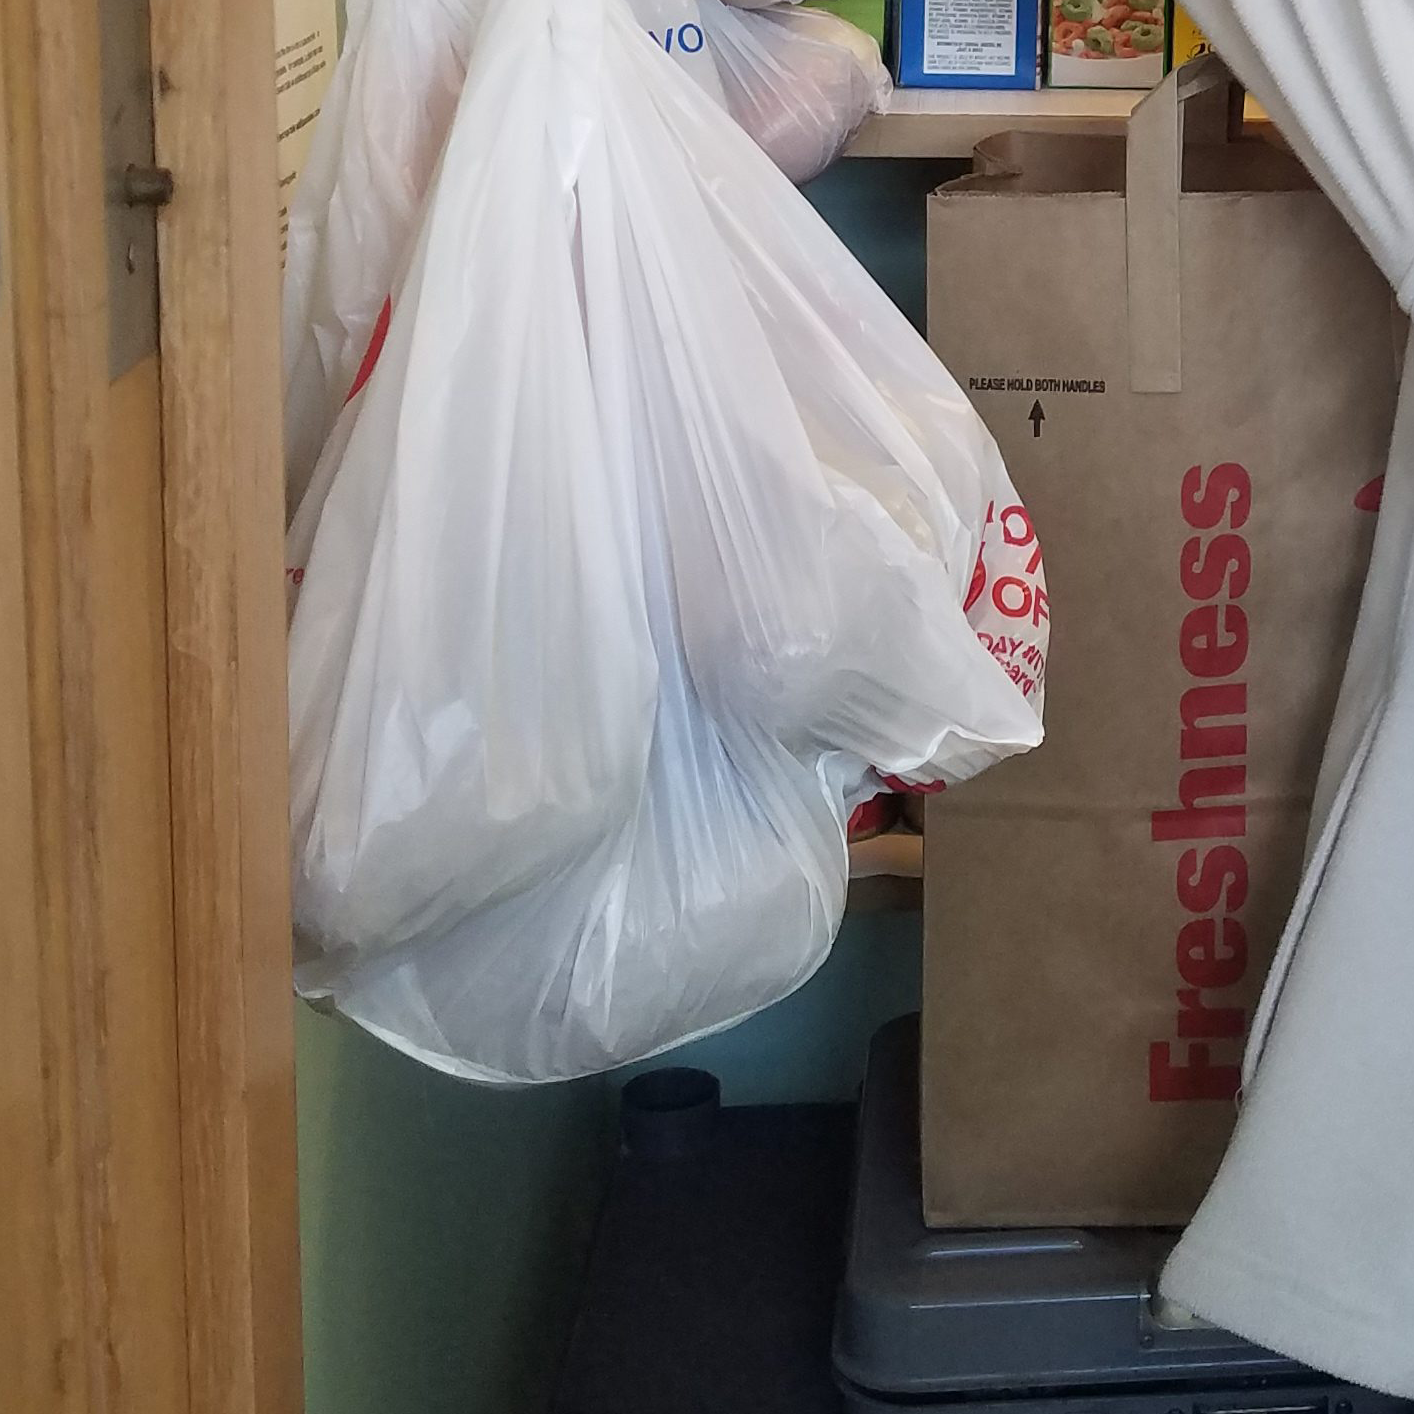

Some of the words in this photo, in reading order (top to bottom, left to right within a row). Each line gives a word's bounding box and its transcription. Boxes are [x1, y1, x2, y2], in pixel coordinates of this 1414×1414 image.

[968, 377, 1006, 391] PLEASE
[1006, 378, 1034, 392] HOLD
[1034, 378, 1061, 392] BOTH
[1062, 379, 1106, 394] HANDLES
[1148, 462, 1253, 1103] Freshness
